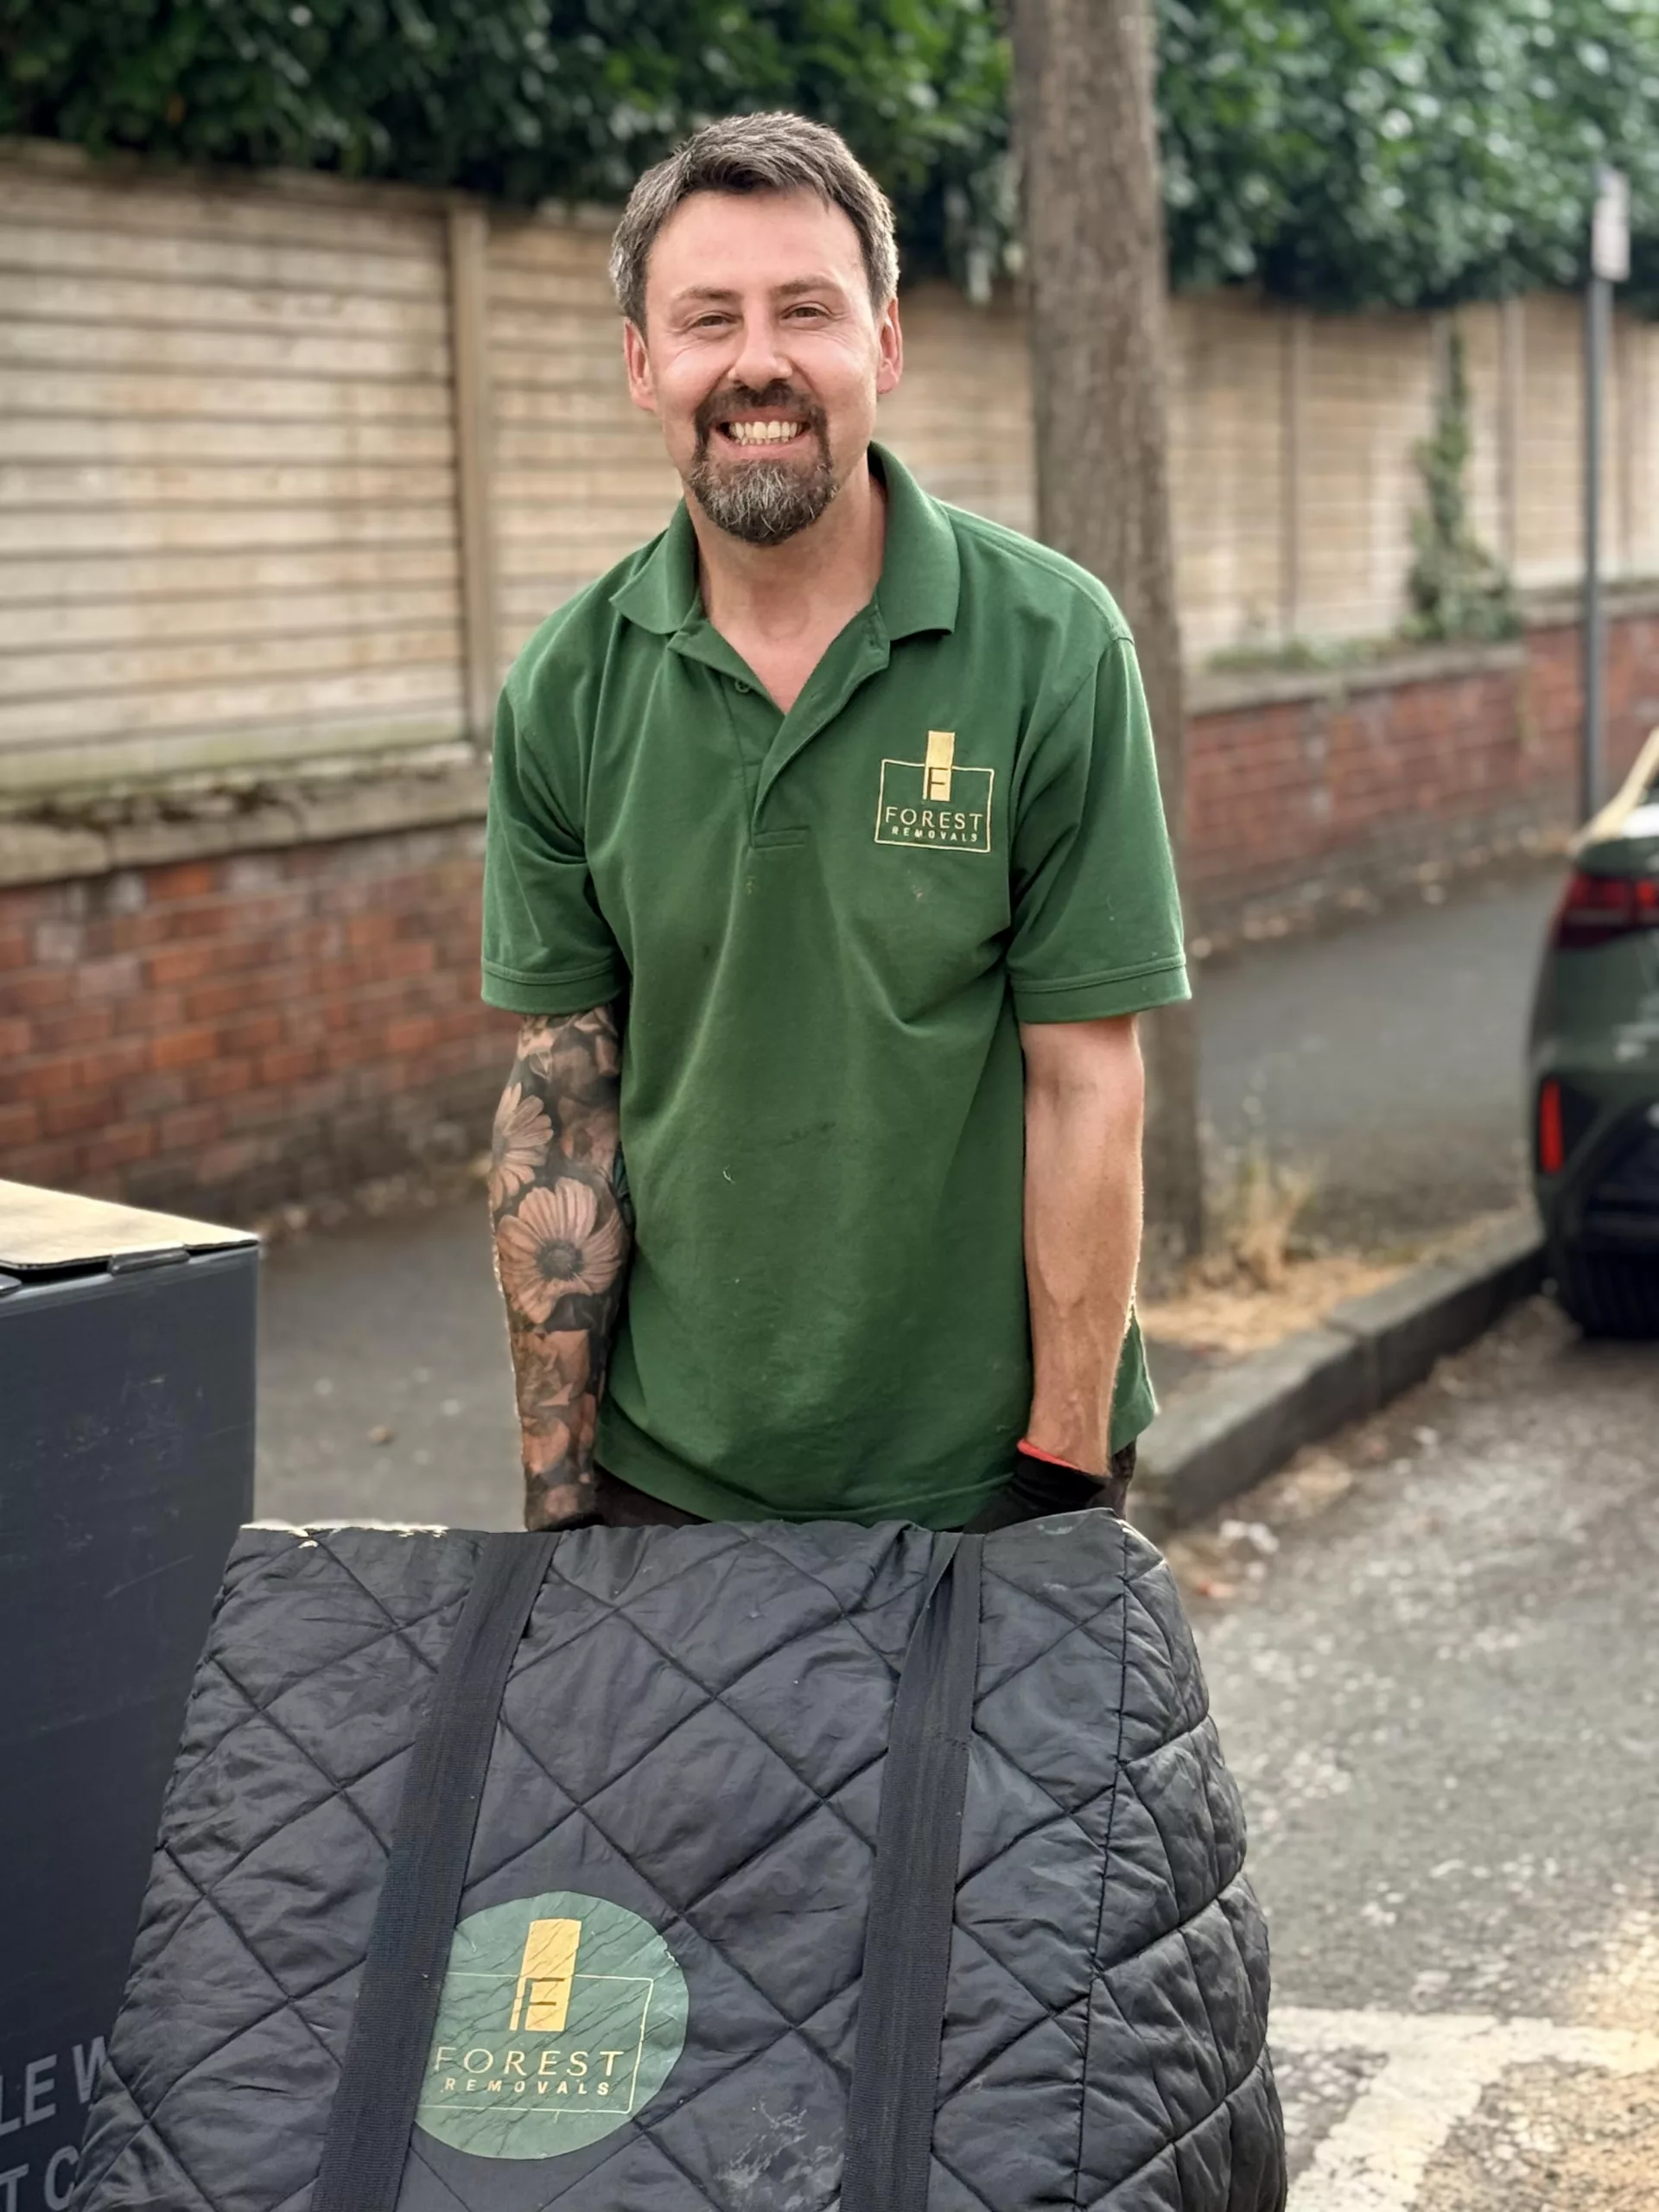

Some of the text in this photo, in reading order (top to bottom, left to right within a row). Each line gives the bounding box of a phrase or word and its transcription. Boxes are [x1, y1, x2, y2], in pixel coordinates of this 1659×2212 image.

[886, 806, 983, 830] FOREST
[892, 826, 977, 842] REMOVALS
[434, 2046, 624, 2076] FOREST
[444, 2077, 610, 2096] REMOVALS
